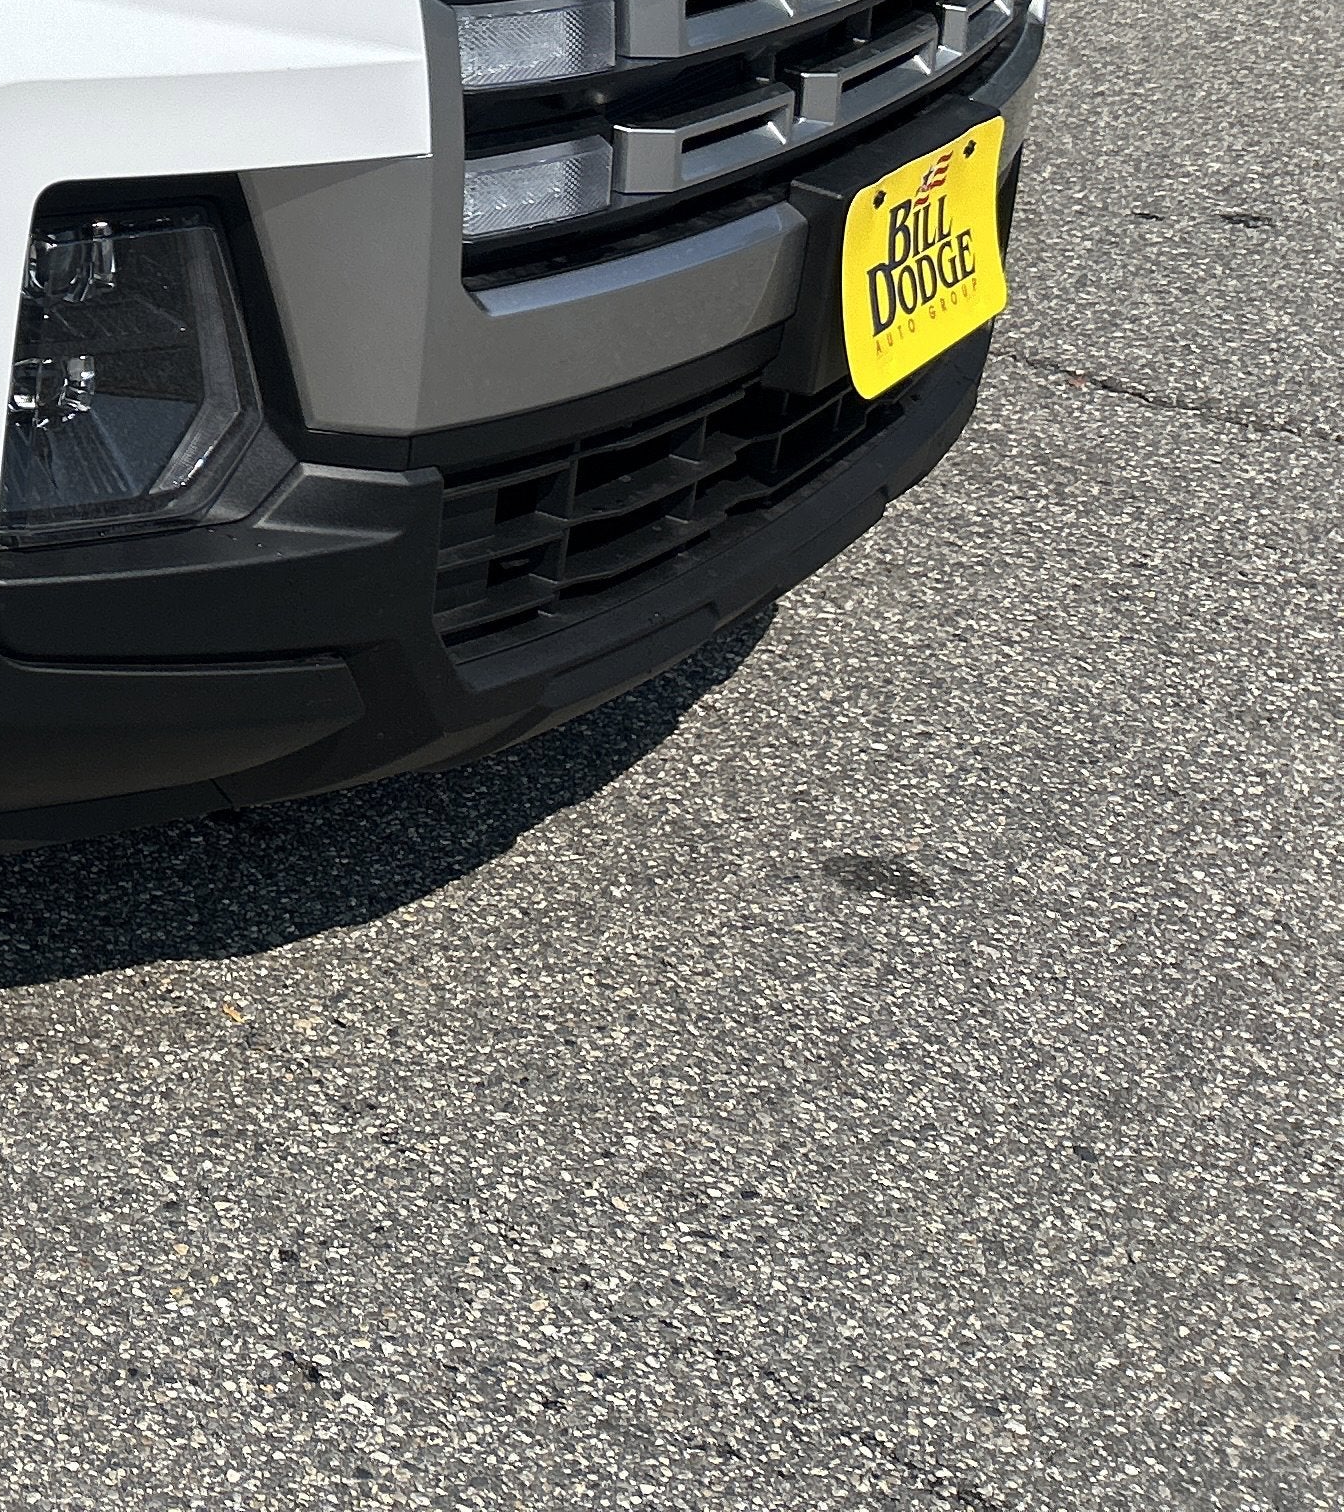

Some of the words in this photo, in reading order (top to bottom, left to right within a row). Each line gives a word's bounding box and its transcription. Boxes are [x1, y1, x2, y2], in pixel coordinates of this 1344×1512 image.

[888, 194, 953, 269] BILL
[866, 229, 976, 338] DODGE
[875, 318, 916, 356] AUTO
[929, 276, 978, 319] GROUP
